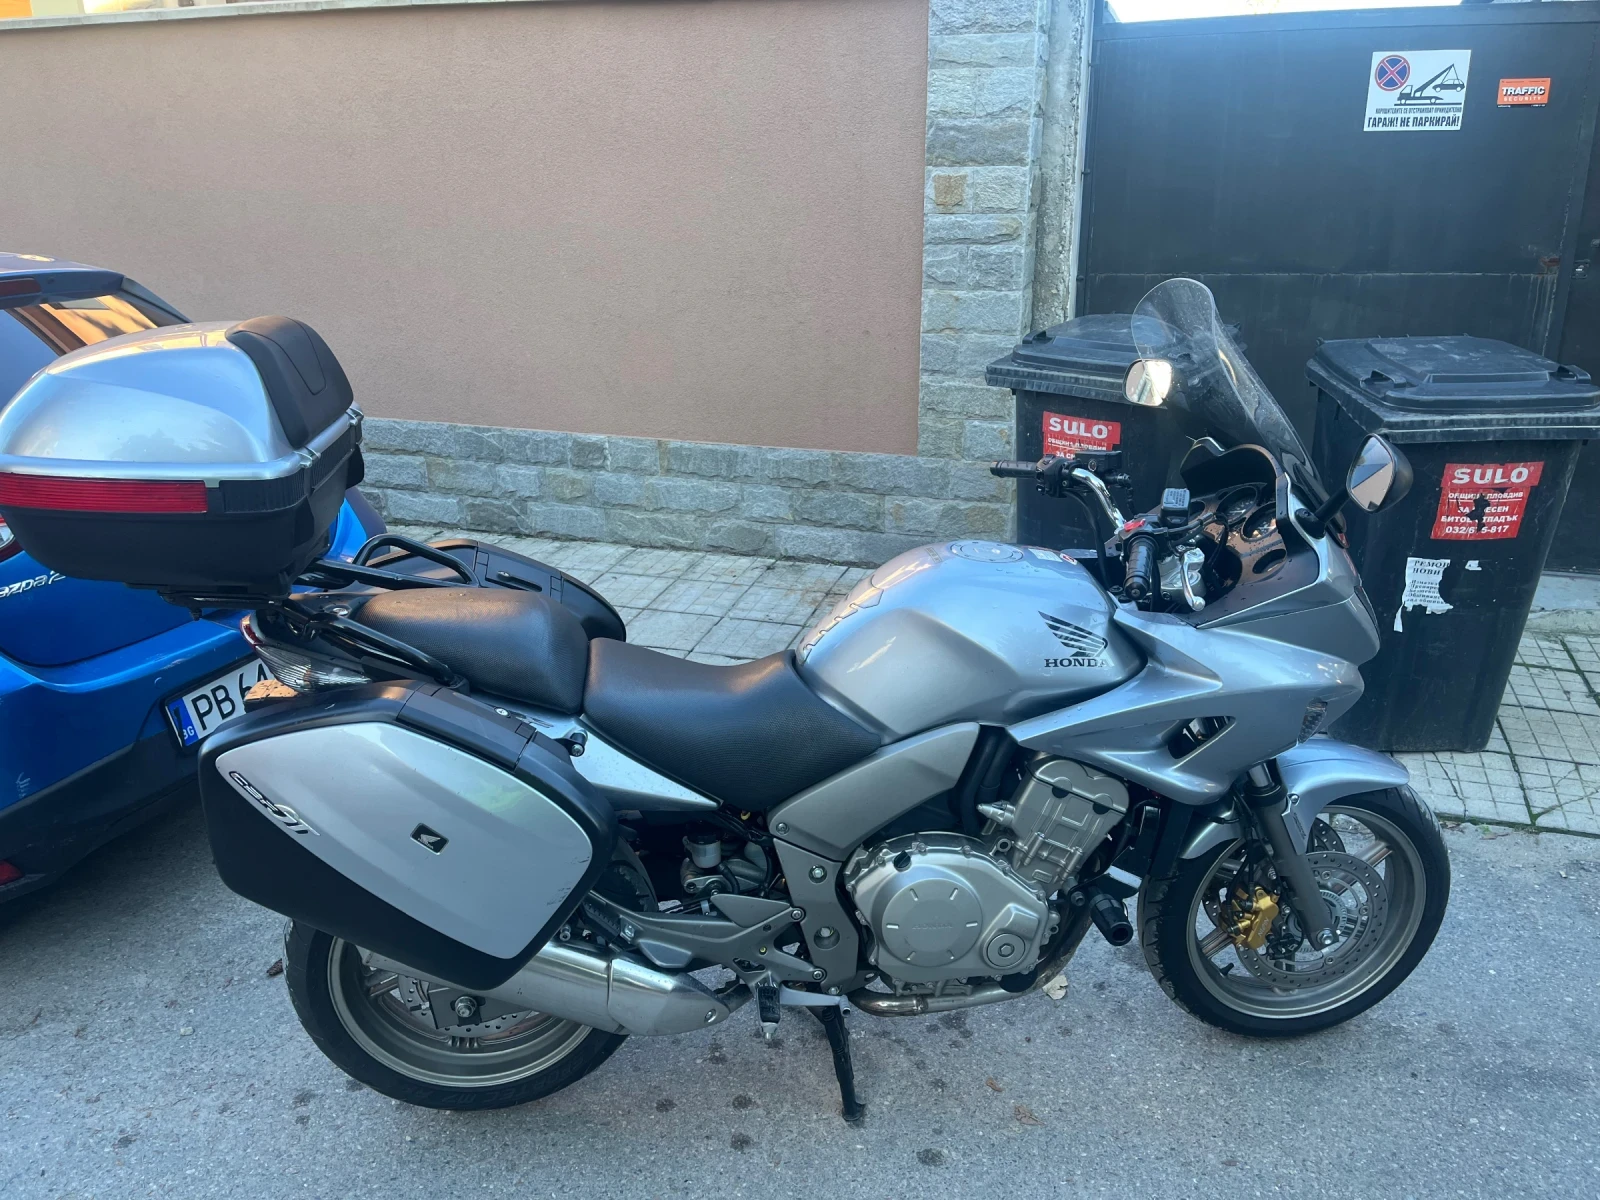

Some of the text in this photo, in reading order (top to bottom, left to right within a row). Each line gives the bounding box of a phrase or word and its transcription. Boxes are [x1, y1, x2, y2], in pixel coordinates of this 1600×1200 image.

[1501, 86, 1546, 96] TRAFFIC
[1367, 114, 1460, 127] ГАРАЖ! НЕ ПАРКИРАЙ!
[1049, 417, 1108, 439] SULO
[1452, 467, 1529, 484] SULO
[1486, 491, 1524, 500] ПЛОВДИВ
[1475, 515, 1518, 523] ТПАДЪК
[1445, 525, 1510, 534] 032/65-817
[1414, 560, 1450, 568] РЕМОН
[1044, 658, 1106, 668] HONDA
[191, 685, 236, 731] PB
